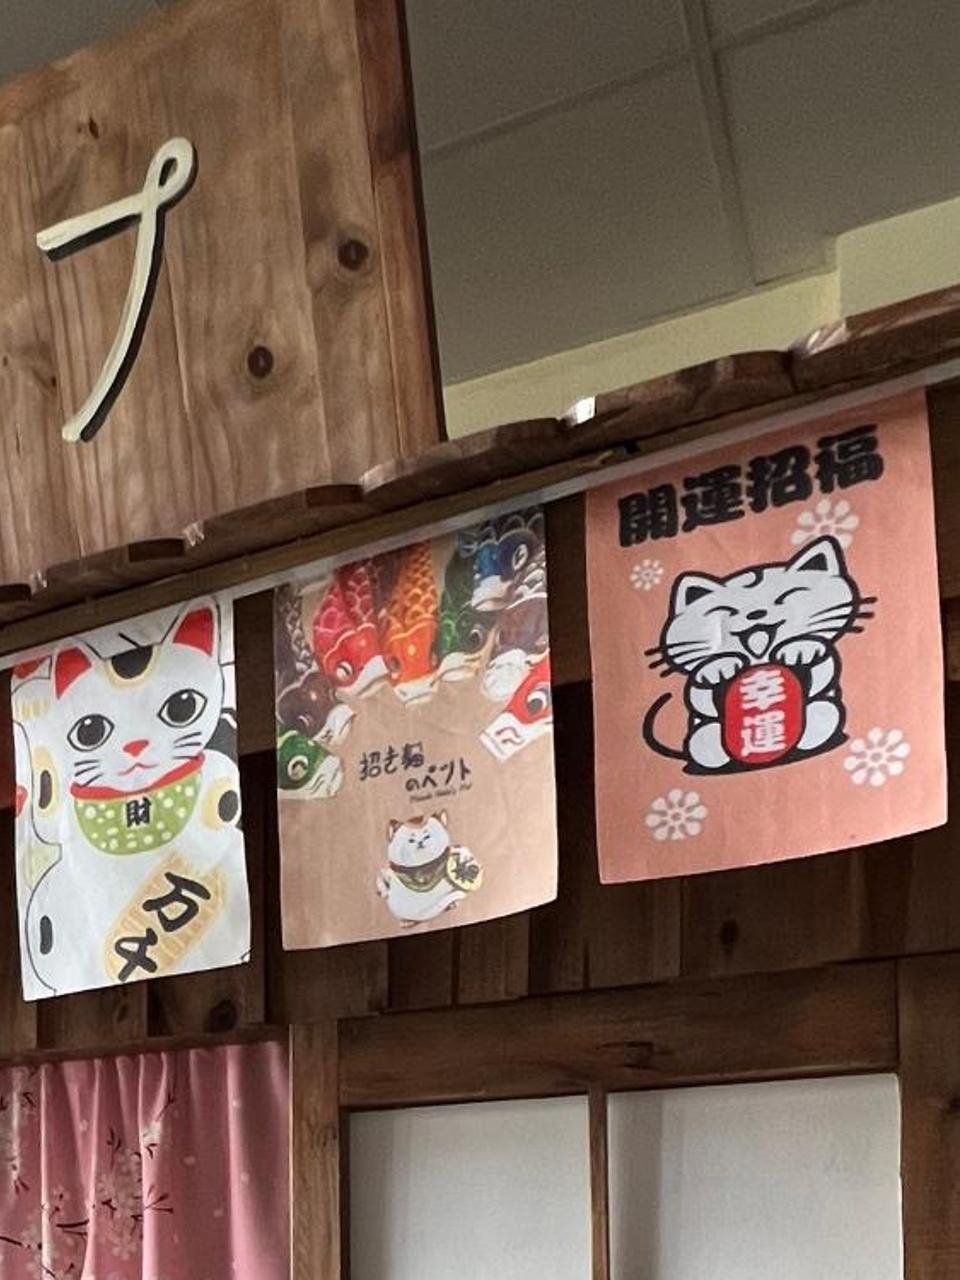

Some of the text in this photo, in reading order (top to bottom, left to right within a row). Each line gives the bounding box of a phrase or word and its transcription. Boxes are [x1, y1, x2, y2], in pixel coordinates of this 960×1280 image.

[619, 424, 884, 547] 開運招福
[739, 669, 787, 757] 幸運
[126, 796, 152, 828] 財
